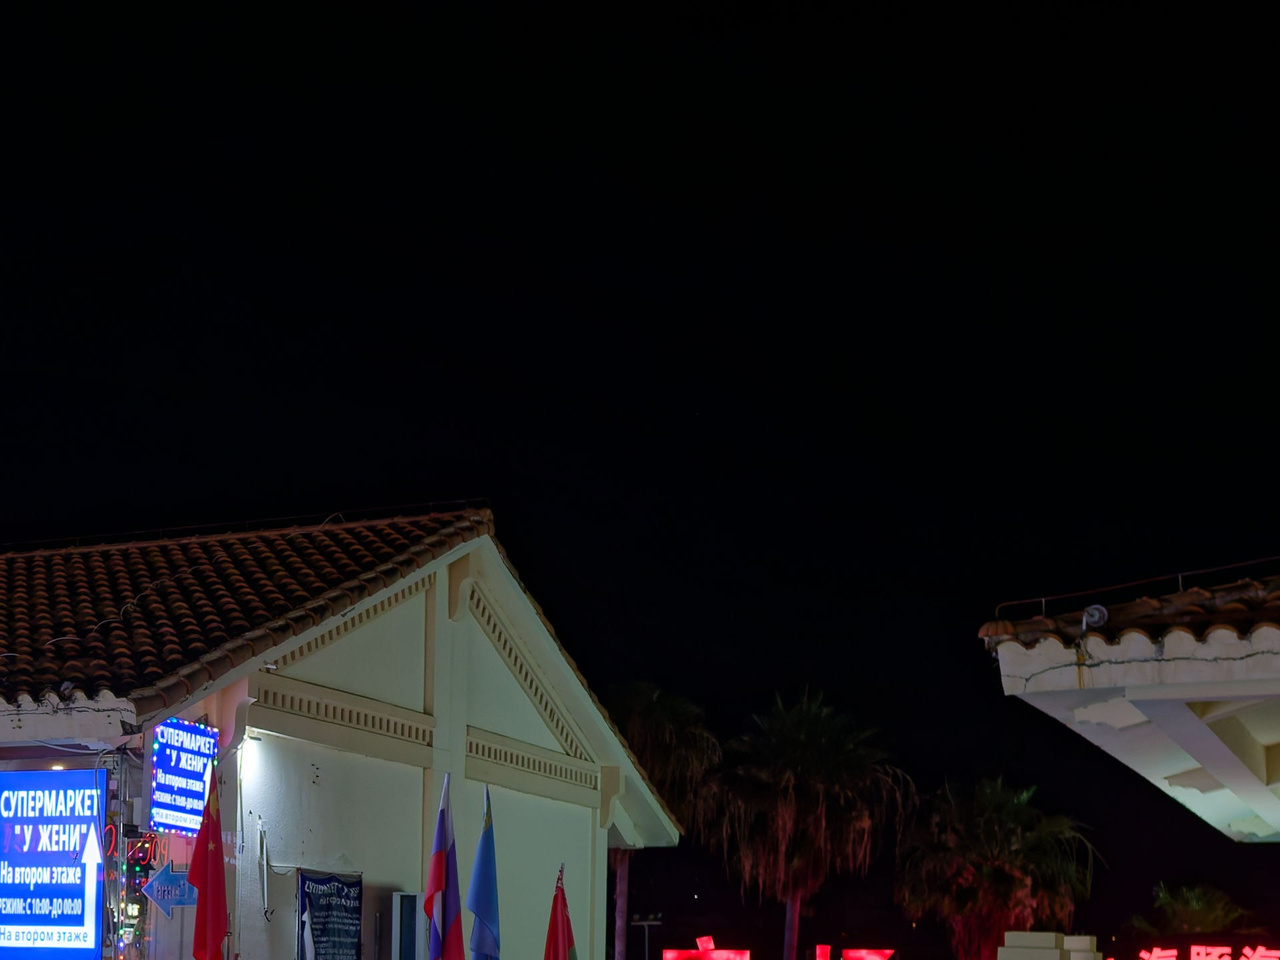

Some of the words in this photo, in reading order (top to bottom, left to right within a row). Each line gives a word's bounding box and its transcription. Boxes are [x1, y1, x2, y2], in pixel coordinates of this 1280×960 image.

[158, 726, 214, 755] СУПЕРМАРКЕТ
[157, 768, 165, 784] На
[165, 773, 187, 791] втором
[187, 778, 204, 792] этаже
[0, 789, 100, 818] СУПЕРМАРКЕТ
[37, 824, 87, 852] ЖЕНИ"
[0, 862, 13, 884] На
[13, 864, 50, 891] втором
[51, 863, 81, 885] этаже
[63, 898, 82, 915] 00:00
[0, 927, 12, 941] На
[15, 930, 54, 946] втором
[57, 931, 88, 943] этаже
